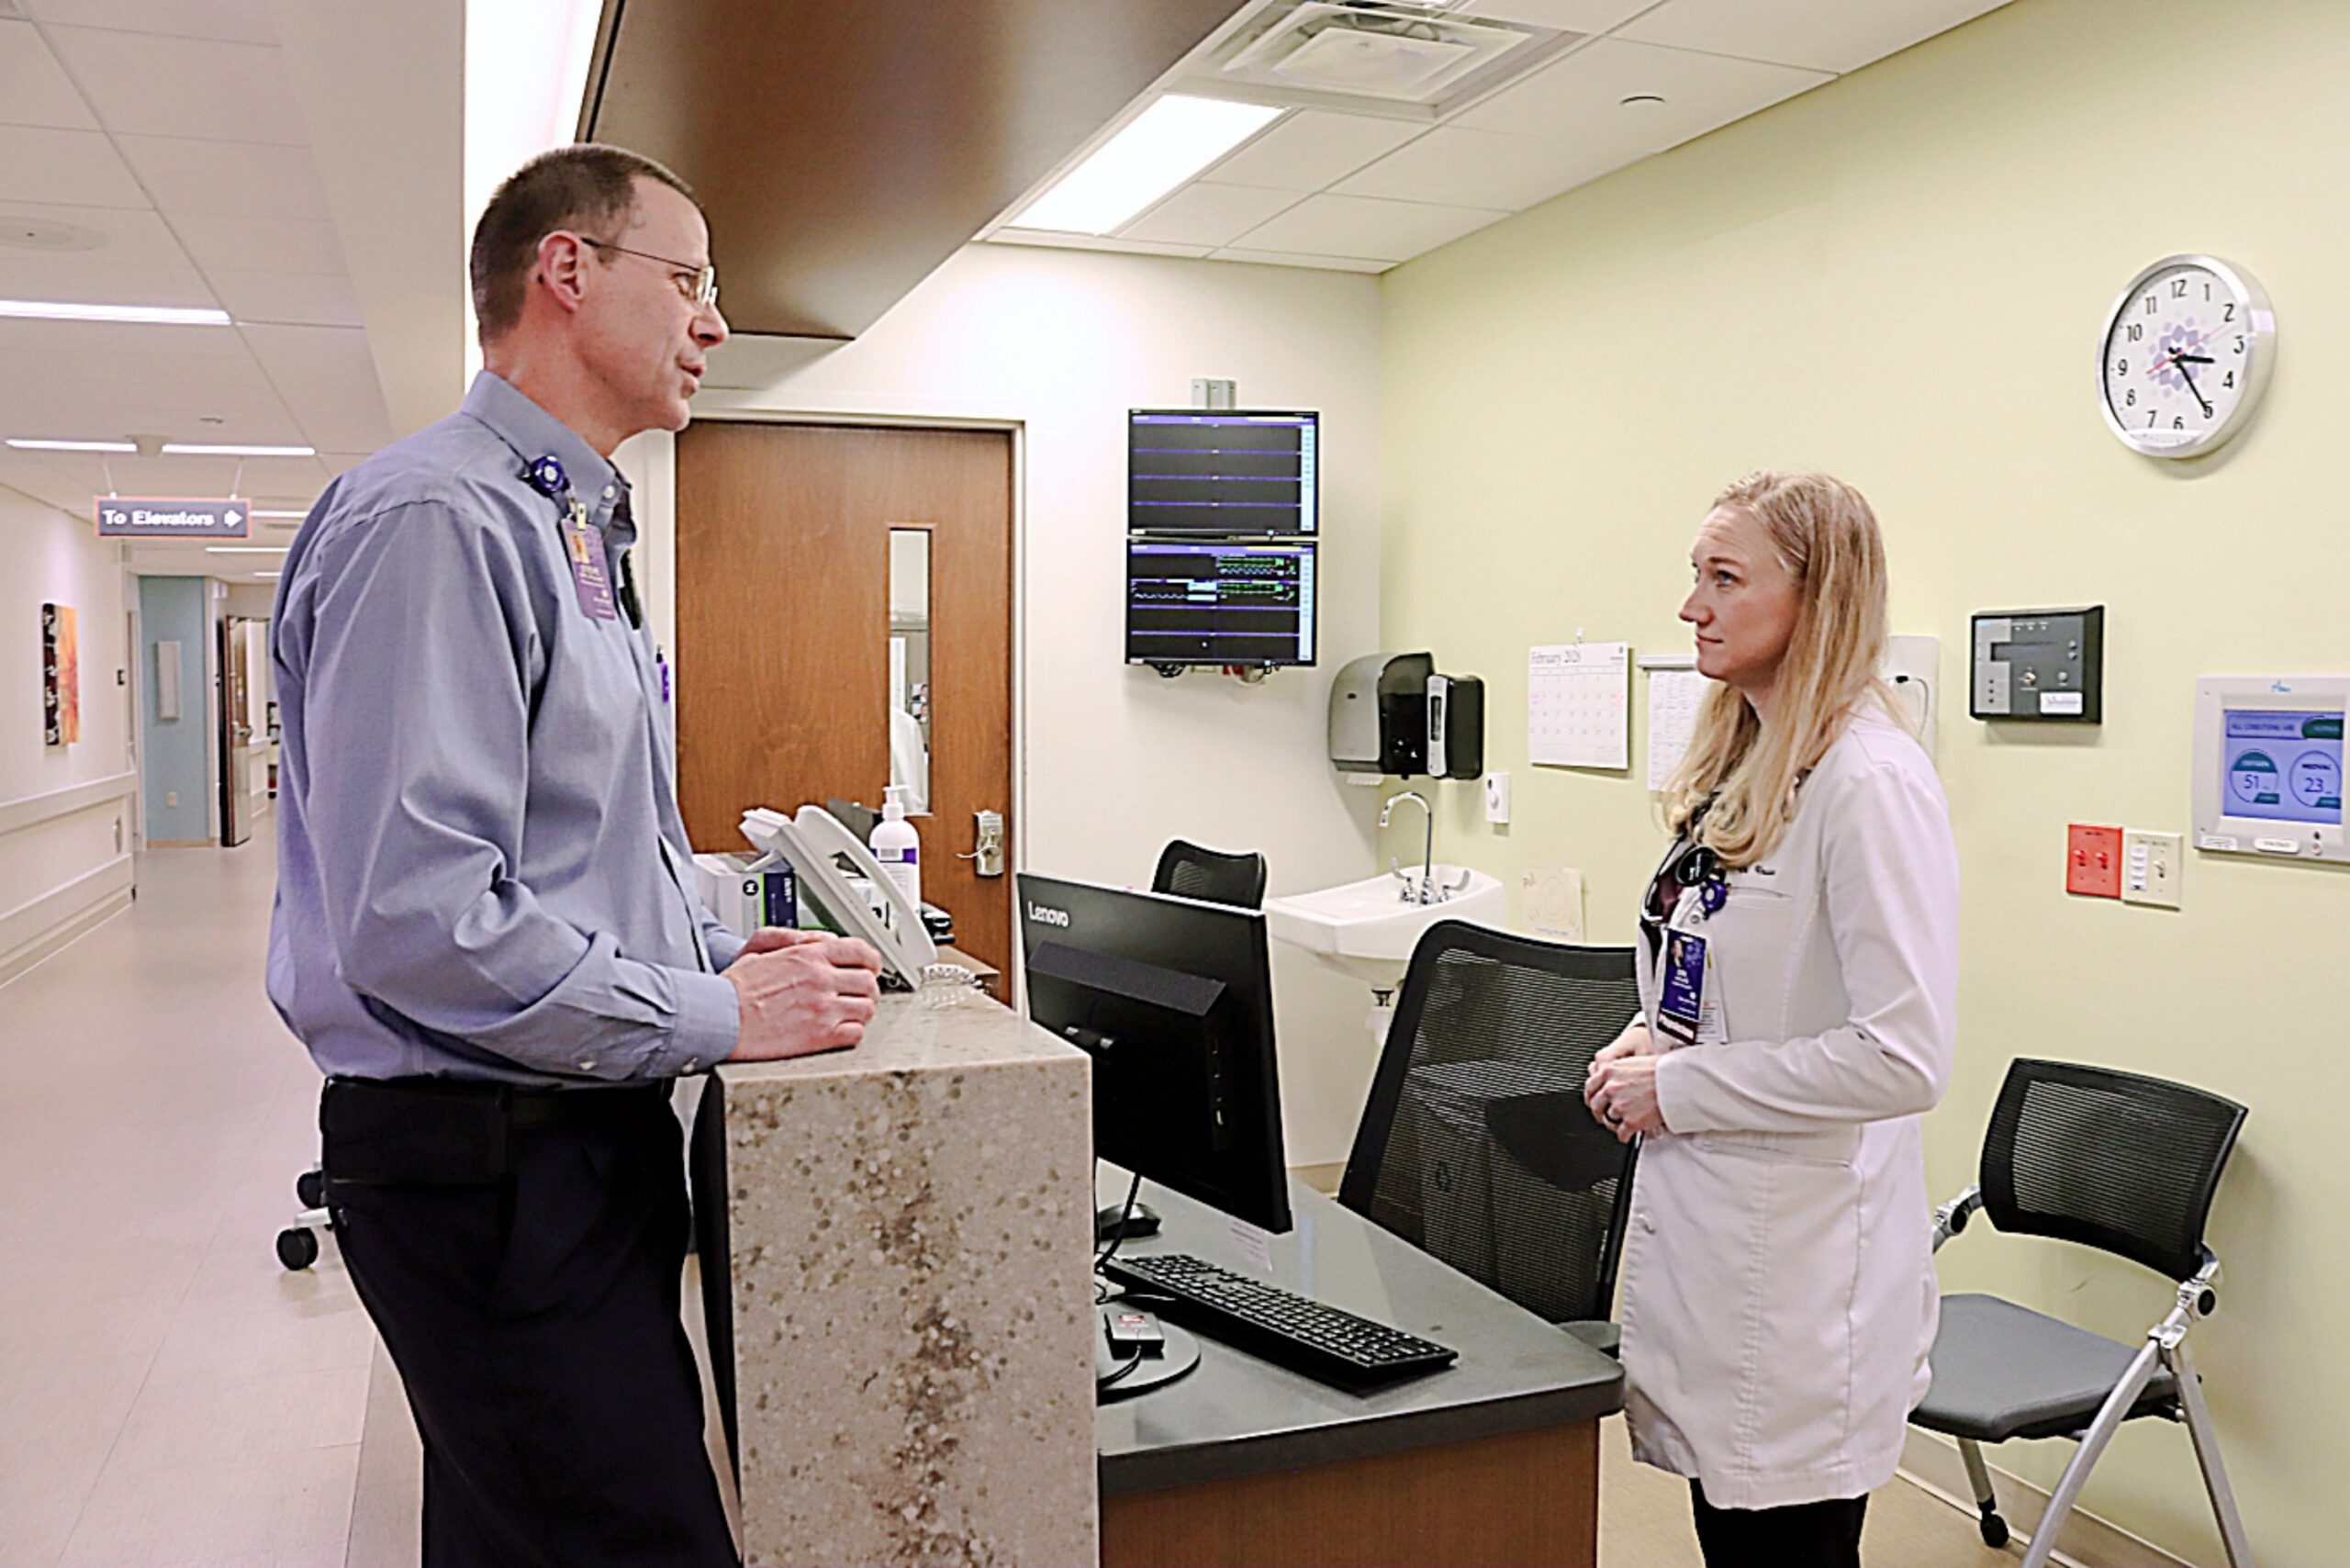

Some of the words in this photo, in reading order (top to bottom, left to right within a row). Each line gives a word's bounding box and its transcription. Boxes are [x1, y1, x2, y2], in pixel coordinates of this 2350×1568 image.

[2171, 279, 2188, 298] 12
[2204, 284, 2210, 301] 1
[2145, 297, 2157, 314] 11
[2223, 303, 2235, 322] 2
[2127, 324, 2143, 342] 10
[2233, 335, 2244, 353] 3
[2118, 359, 2128, 375] 9
[2222, 371, 2233, 389] 4
[2126, 389, 2137, 407] 8
[2147, 410, 2157, 428] 7
[2174, 416, 2184, 430] 6
[102, 510, 127, 525] To
[132, 510, 215, 526] Elevators
[2243, 774, 2259, 790] 51
[2304, 777, 2324, 792] 23
[1028, 901, 1069, 927] Lenovo
